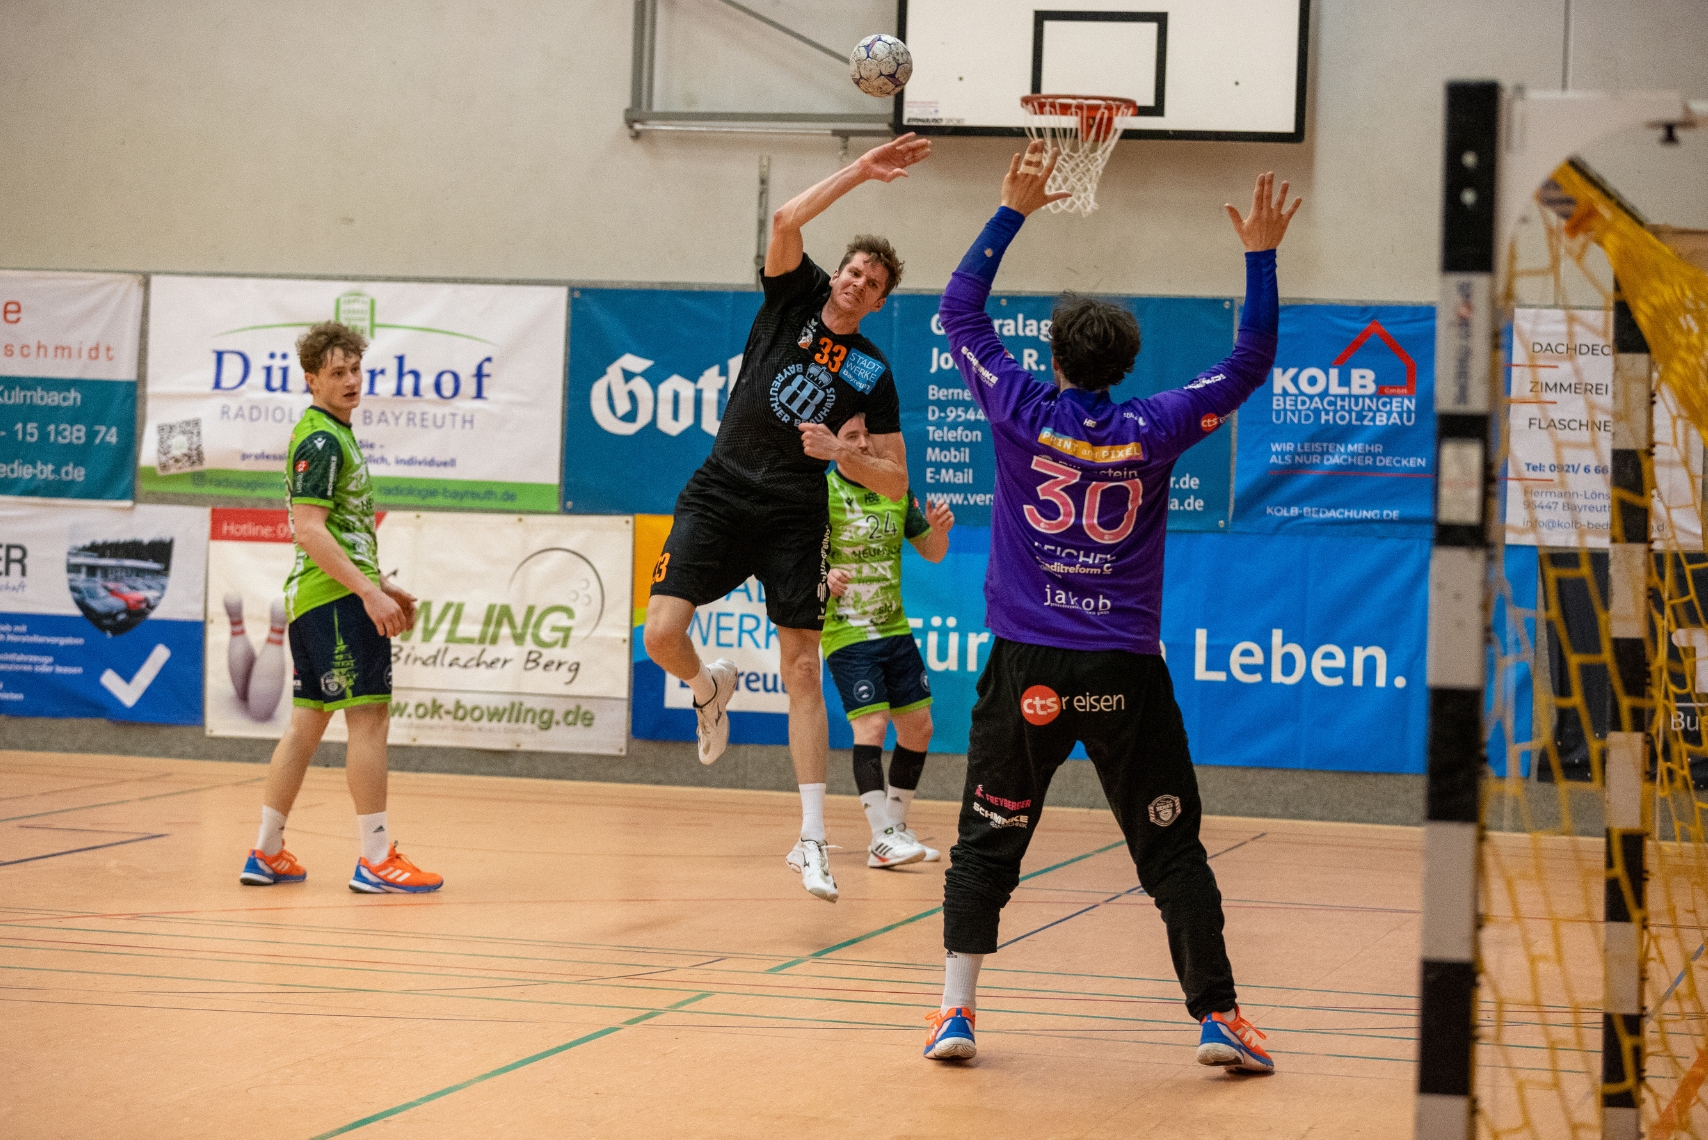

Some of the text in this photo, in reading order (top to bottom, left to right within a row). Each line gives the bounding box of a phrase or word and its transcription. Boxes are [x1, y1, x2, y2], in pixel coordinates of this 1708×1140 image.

[814, 336, 848, 373] 33
[1531, 341, 1612, 357] DACHDEC
[849, 352, 883, 373] STADT
[929, 347, 1047, 373] Jo R.
[845, 360, 877, 383] WERKE
[1272, 367, 1377, 396] KOLB
[769, 363, 804, 424] BAYREUTHER
[928, 385, 973, 401] Berne
[1529, 380, 1609, 396] ZIMMEREI
[1272, 396, 1416, 412] BEDACHUNGEN
[362, 409, 475, 430] BAYREUTH
[1272, 410, 1416, 426] UND HOLZBAU
[1528, 417, 1612, 433] FLASCHNE
[14, 422, 38, 443] 15
[47, 424, 86, 445] 138
[93, 425, 118, 446] 74
[926, 425, 982, 443] Telefon
[926, 446, 970, 464] Mobil
[1101, 445, 1141, 460] PIXEL
[1270, 442, 1383, 454] WIR LEISTEN MEHR
[0, 459, 86, 482] edie-bt.de
[1269, 454, 1293, 465] ALS
[1294, 454, 1321, 465] NUR
[1376, 455, 1427, 468] DECKEN
[1525, 463, 1546, 472] Tel:
[926, 468, 974, 484] E-Mail
[1023, 454, 1143, 545] 30
[1523, 489, 1611, 501] Hermann-Löns
[865, 511, 898, 540] 24
[1522, 518, 1611, 532] info@kolb-bed
[1043, 584, 1112, 612] jakob
[399, 599, 576, 649] WLING
[522, 649, 581, 686] Berg
[1194, 627, 1408, 689] Leben.
[390, 697, 595, 731] w.ok-bowling.de
[1022, 695, 1059, 716] cts
